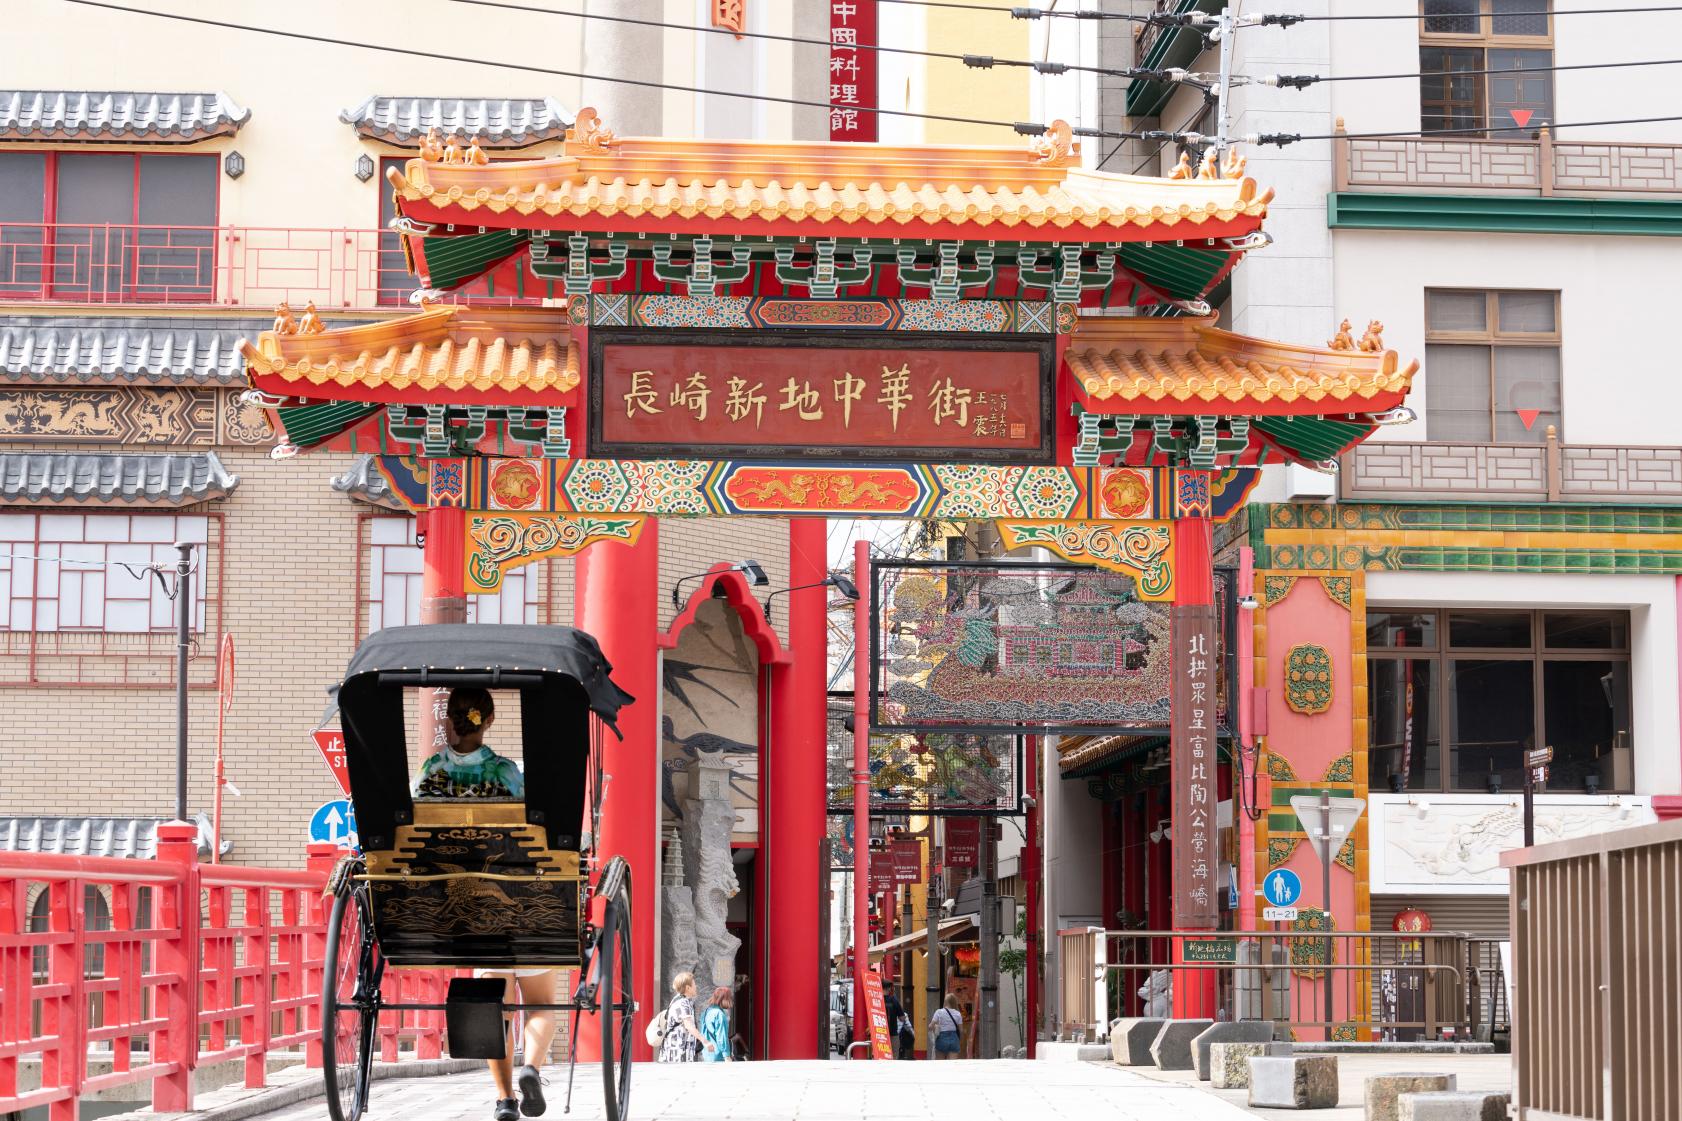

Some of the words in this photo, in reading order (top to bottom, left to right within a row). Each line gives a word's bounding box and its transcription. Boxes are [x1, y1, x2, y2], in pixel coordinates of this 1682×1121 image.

[622, 362, 972, 433] 長崎新地中華街
[334, 755, 348, 768] ST
[1266, 910, 1295, 918] 11-21
